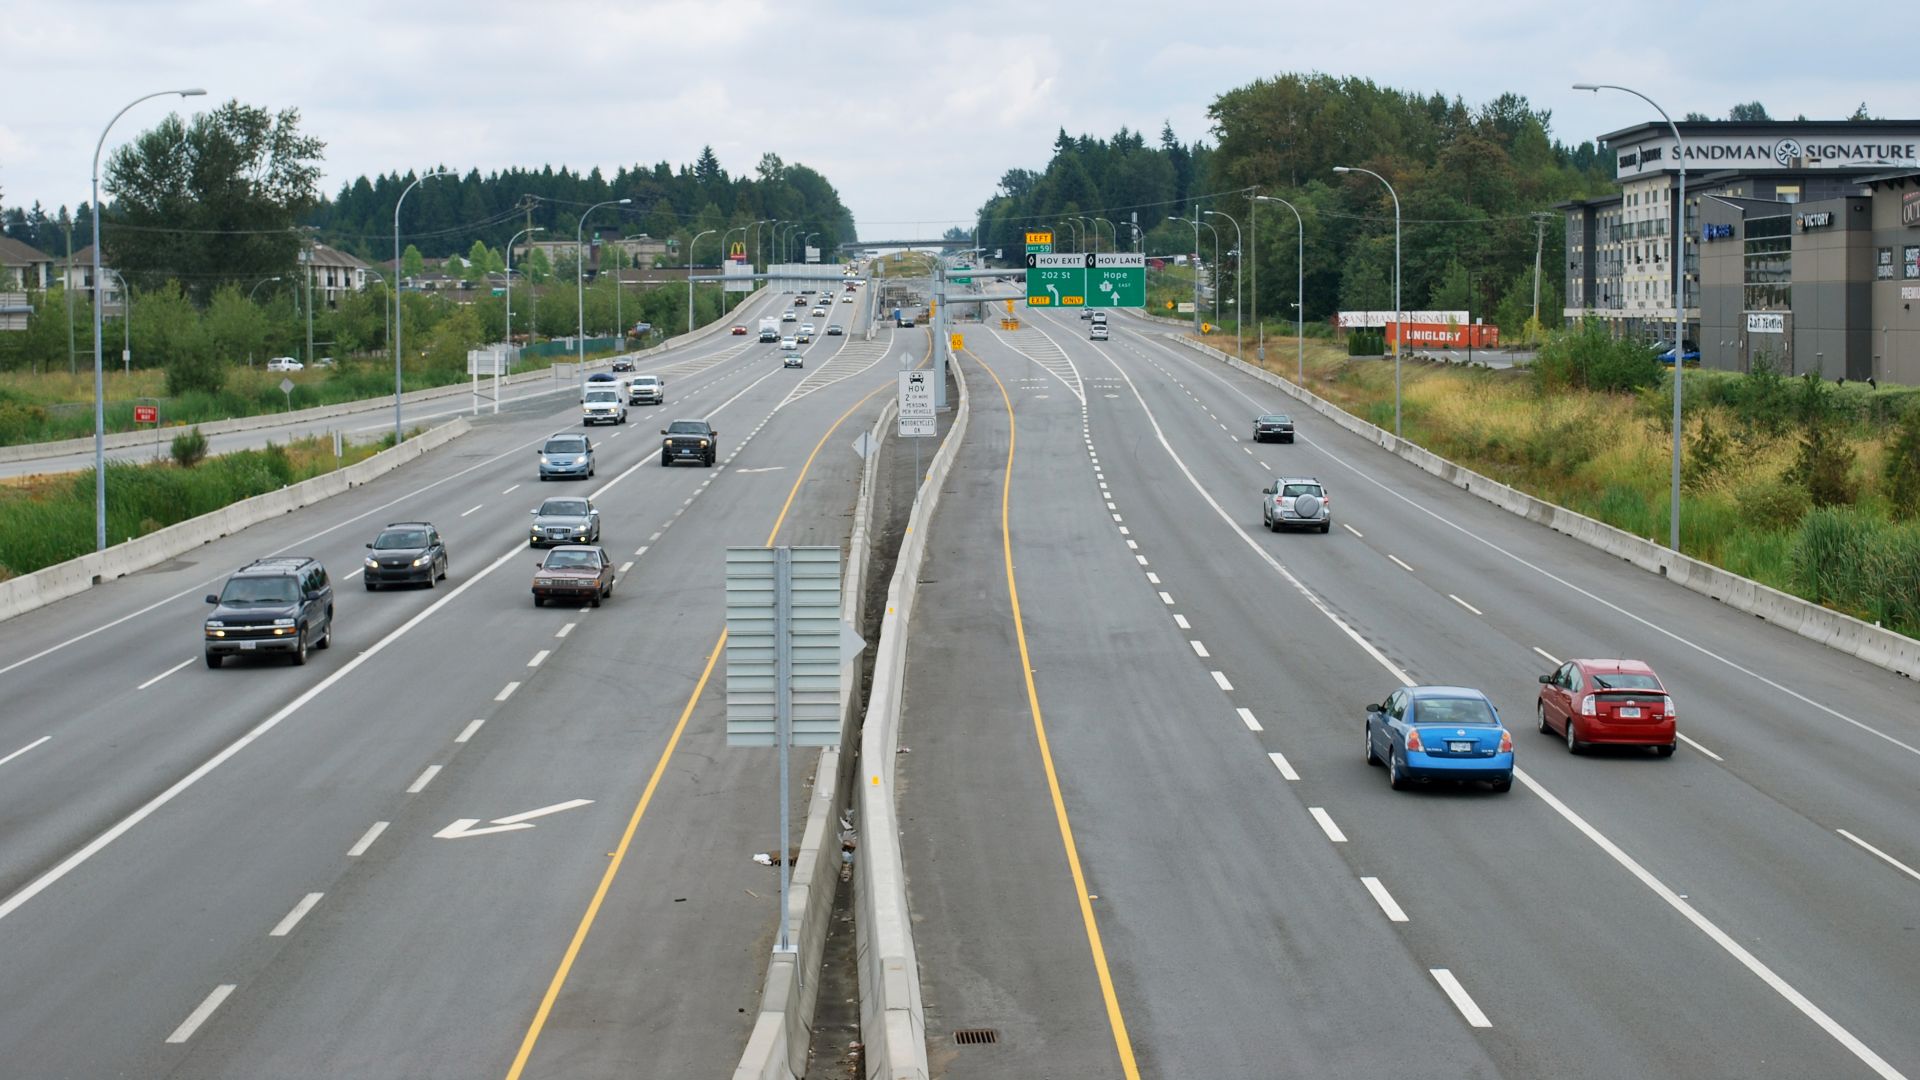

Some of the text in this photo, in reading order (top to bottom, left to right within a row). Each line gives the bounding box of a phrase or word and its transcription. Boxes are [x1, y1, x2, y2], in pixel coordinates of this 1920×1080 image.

[1672, 145, 1771, 160] SANDMAN
[1805, 144, 1916, 159] SIGNATURE
[1804, 212, 1830, 227] VICTORY
[1040, 257, 1081, 265] HOV EXIT
[1098, 257, 1116, 265] HOV
[1041, 271, 1071, 279] 202 St
[1103, 271, 1128, 280] Hope
[1031, 296, 1081, 304] EXIT ONLY
[1406, 330, 1461, 341] UNIGLORY
[905, 393, 910, 401] 2
